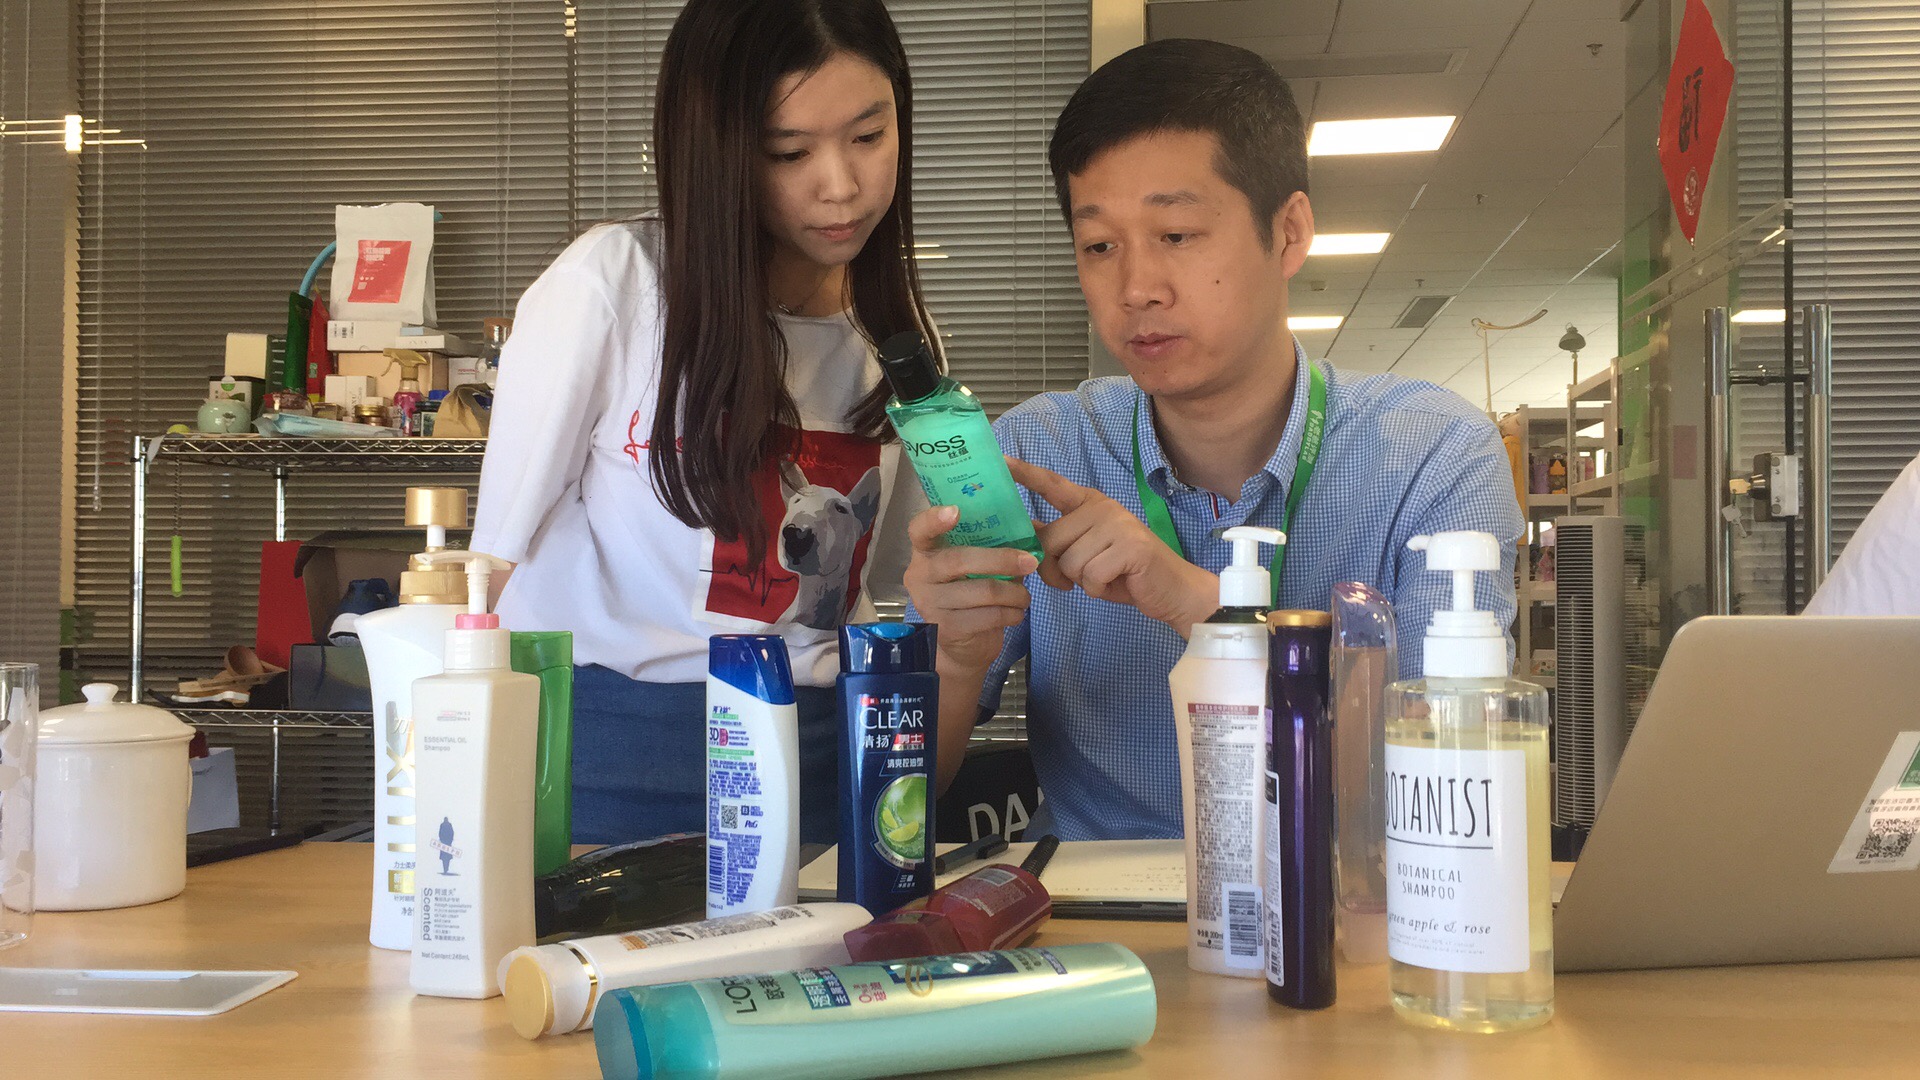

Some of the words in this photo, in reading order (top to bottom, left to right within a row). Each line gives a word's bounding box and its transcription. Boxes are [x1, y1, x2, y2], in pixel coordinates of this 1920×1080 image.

[860, 707, 924, 729] CLEAR
[863, 734, 890, 749] 清扬
[898, 734, 922, 744] 男士
[1397, 863, 1462, 883] BOTANICAL
[1402, 881, 1455, 900] SHAMPOO
[423, 887, 433, 941] Scented
[1408, 916, 1439, 933] apple
[1464, 924, 1491, 935] rose
